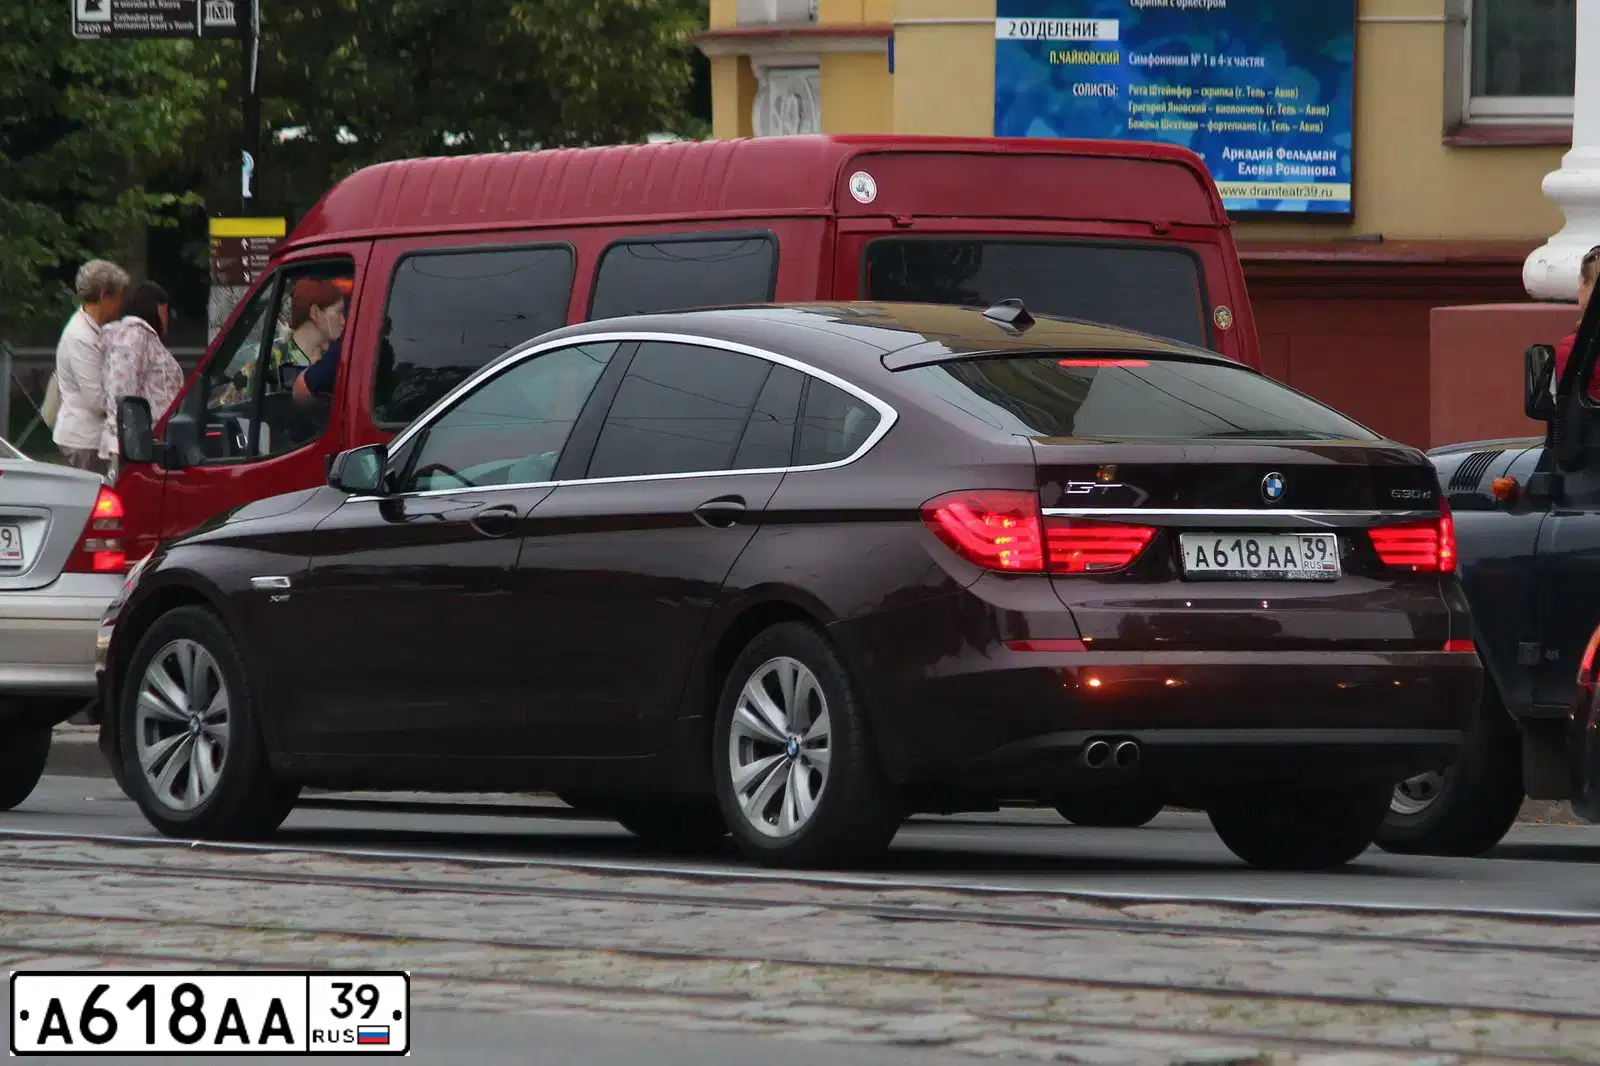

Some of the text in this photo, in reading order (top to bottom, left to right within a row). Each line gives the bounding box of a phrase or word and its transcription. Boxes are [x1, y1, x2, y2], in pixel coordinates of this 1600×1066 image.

[1009, 22, 1100, 40] 2 ОТДЕЛЕНИЕ
[1072, 82, 1119, 97] СОЛИСТЫ:
[1201, 87, 1234, 100] скрипка
[1222, 146, 1274, 161] Аркадий
[1276, 148, 1338, 161] Фельдман
[1238, 162, 1337, 177] Елена Романова
[1219, 185, 1333, 198] www.dramteatr39.ru
[1302, 538, 1327, 560] 39
[1304, 561, 1322, 569] RUS
